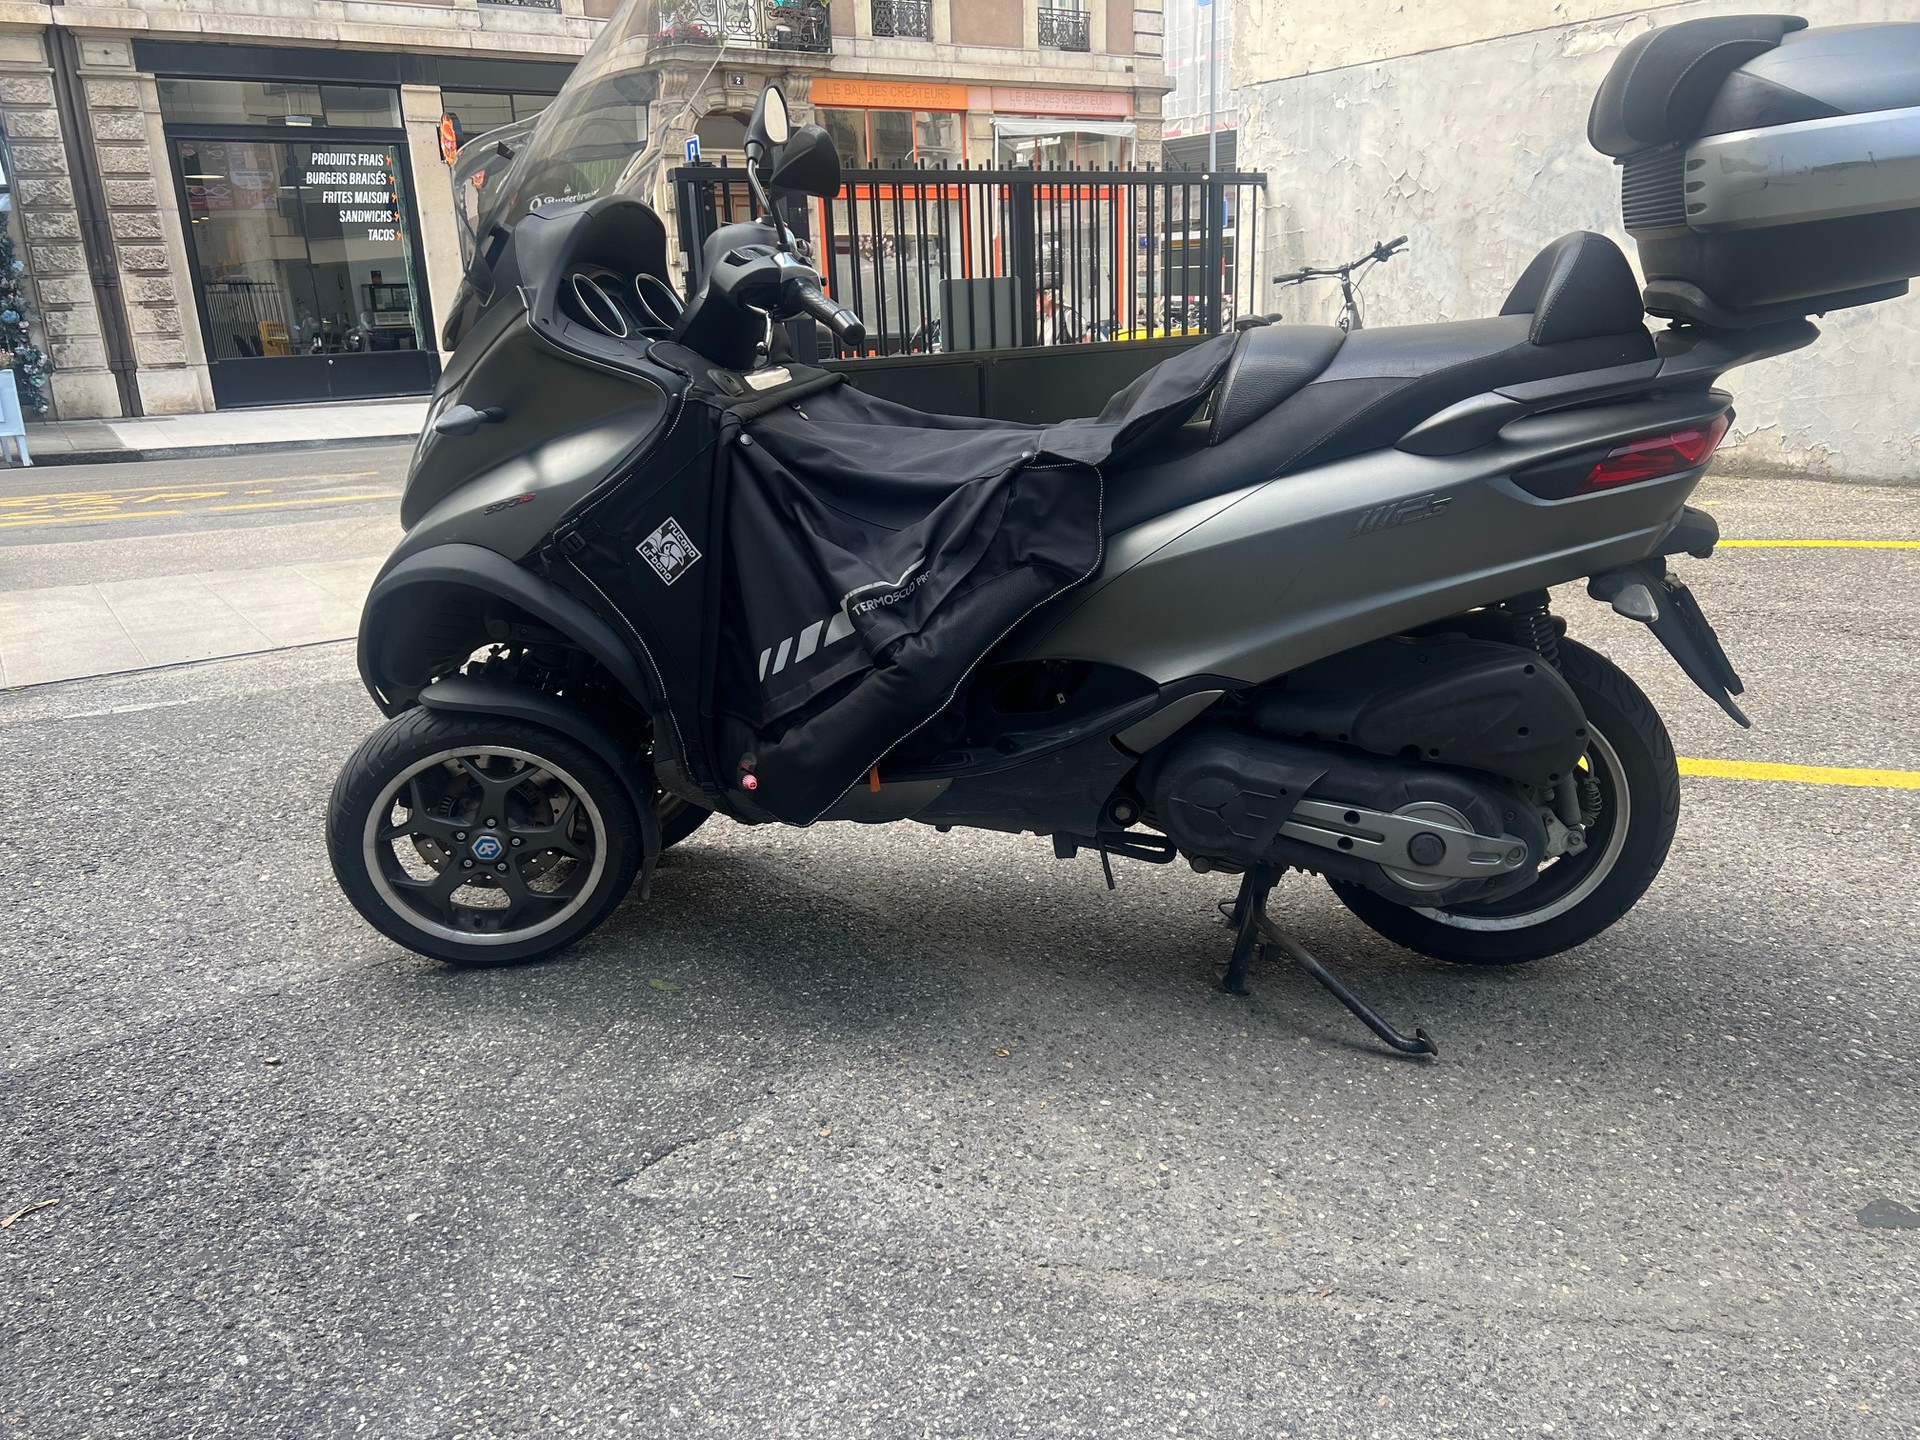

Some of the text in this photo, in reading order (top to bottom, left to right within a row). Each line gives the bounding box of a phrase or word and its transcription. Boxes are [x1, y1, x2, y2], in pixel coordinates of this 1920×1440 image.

[735, 76, 742, 85] 2
[826, 83, 841, 96] LE
[844, 83, 865, 97] BAL
[868, 84, 887, 98] DES
[1009, 91, 1022, 102] LE
[1024, 91, 1040, 103] BAL
[1043, 93, 1060, 104] DES
[311, 152, 384, 167] PRODUITS FRAIS
[306, 170, 387, 185] BURGERS BRAISÉS
[322, 190, 390, 204] FRITES MAISON
[339, 209, 393, 223] SANDWICHS
[367, 228, 395, 241] TACOS
